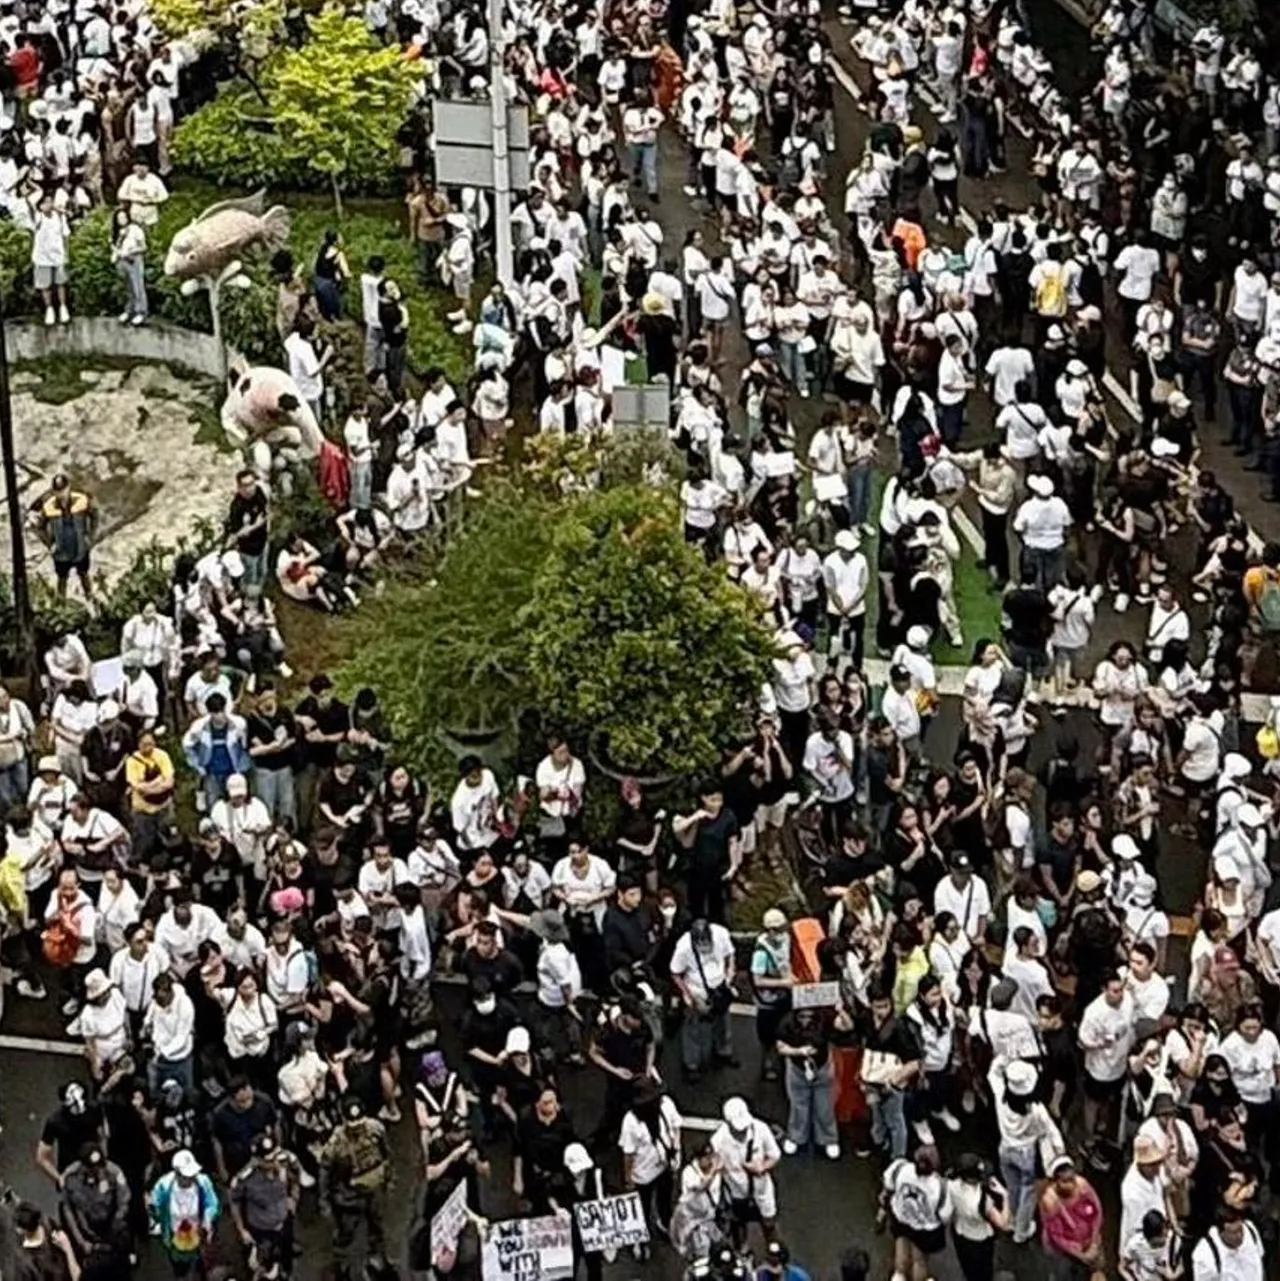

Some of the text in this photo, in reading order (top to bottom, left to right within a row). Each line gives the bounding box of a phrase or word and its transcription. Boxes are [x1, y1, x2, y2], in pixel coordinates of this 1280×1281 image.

[575, 1195, 638, 1230] GAMOT
[499, 1222, 523, 1238] WE
[494, 1233, 525, 1255] YOU
[499, 1250, 540, 1273] WITH
